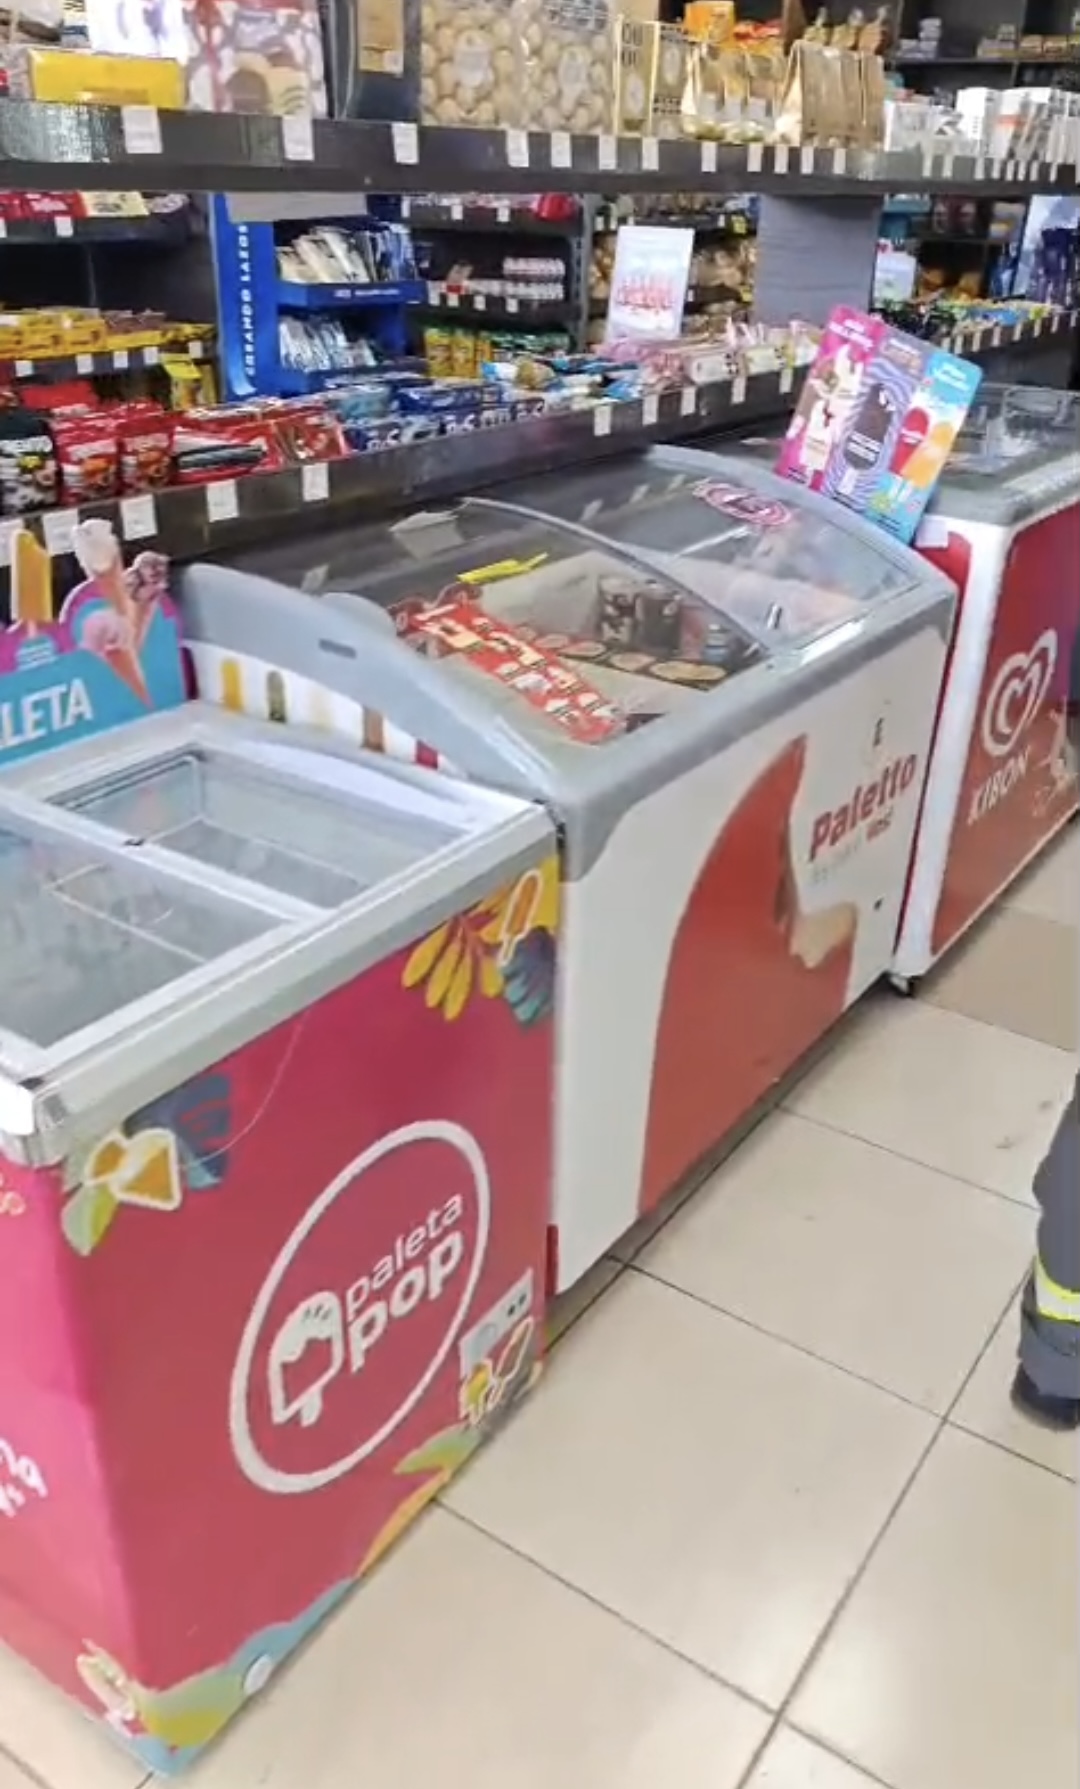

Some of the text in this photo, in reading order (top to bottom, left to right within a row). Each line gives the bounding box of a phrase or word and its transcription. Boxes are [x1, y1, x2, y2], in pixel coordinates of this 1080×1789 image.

[0, 677, 94, 751] LETA
[345, 1193, 464, 1321] paleta
[349, 1230, 465, 1374] pop
